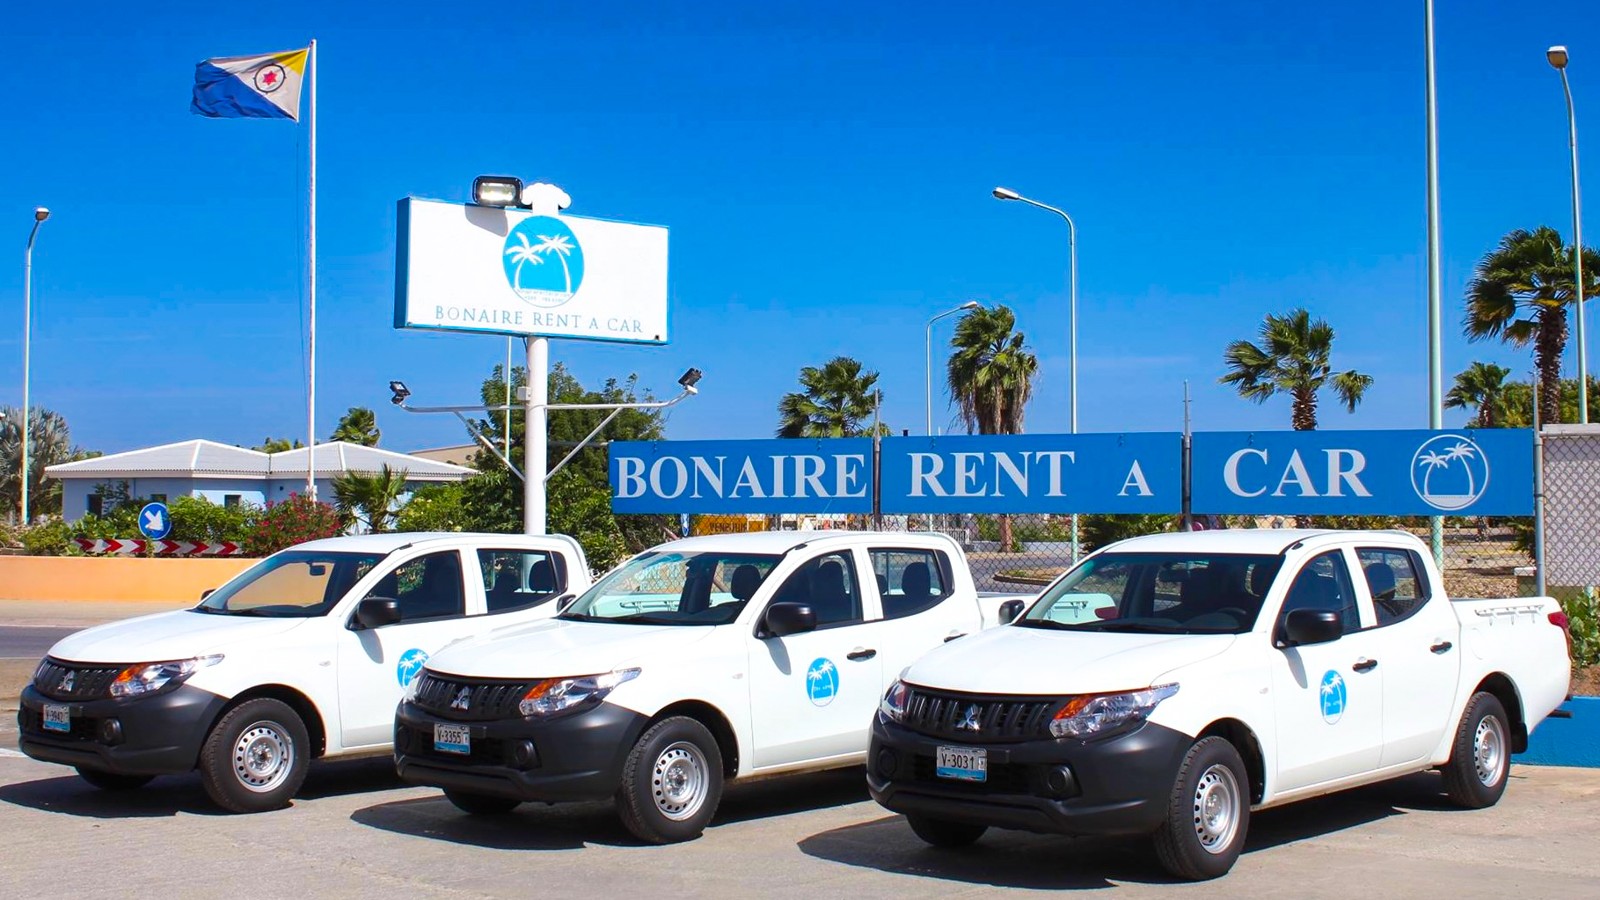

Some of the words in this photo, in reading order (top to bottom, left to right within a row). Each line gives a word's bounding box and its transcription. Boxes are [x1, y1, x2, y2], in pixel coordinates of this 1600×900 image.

[435, 305, 523, 325] BONAIRE
[533, 312, 580, 328] RENT
[588, 316, 600, 330] A
[606, 318, 644, 333] CAR
[614, 454, 867, 499] BONAIRE
[906, 451, 1075, 498] RENT
[1117, 459, 1155, 497] A
[1223, 448, 1373, 498] CAR
[438, 730, 461, 743] V-3355
[942, 753, 974, 769] V-3031
